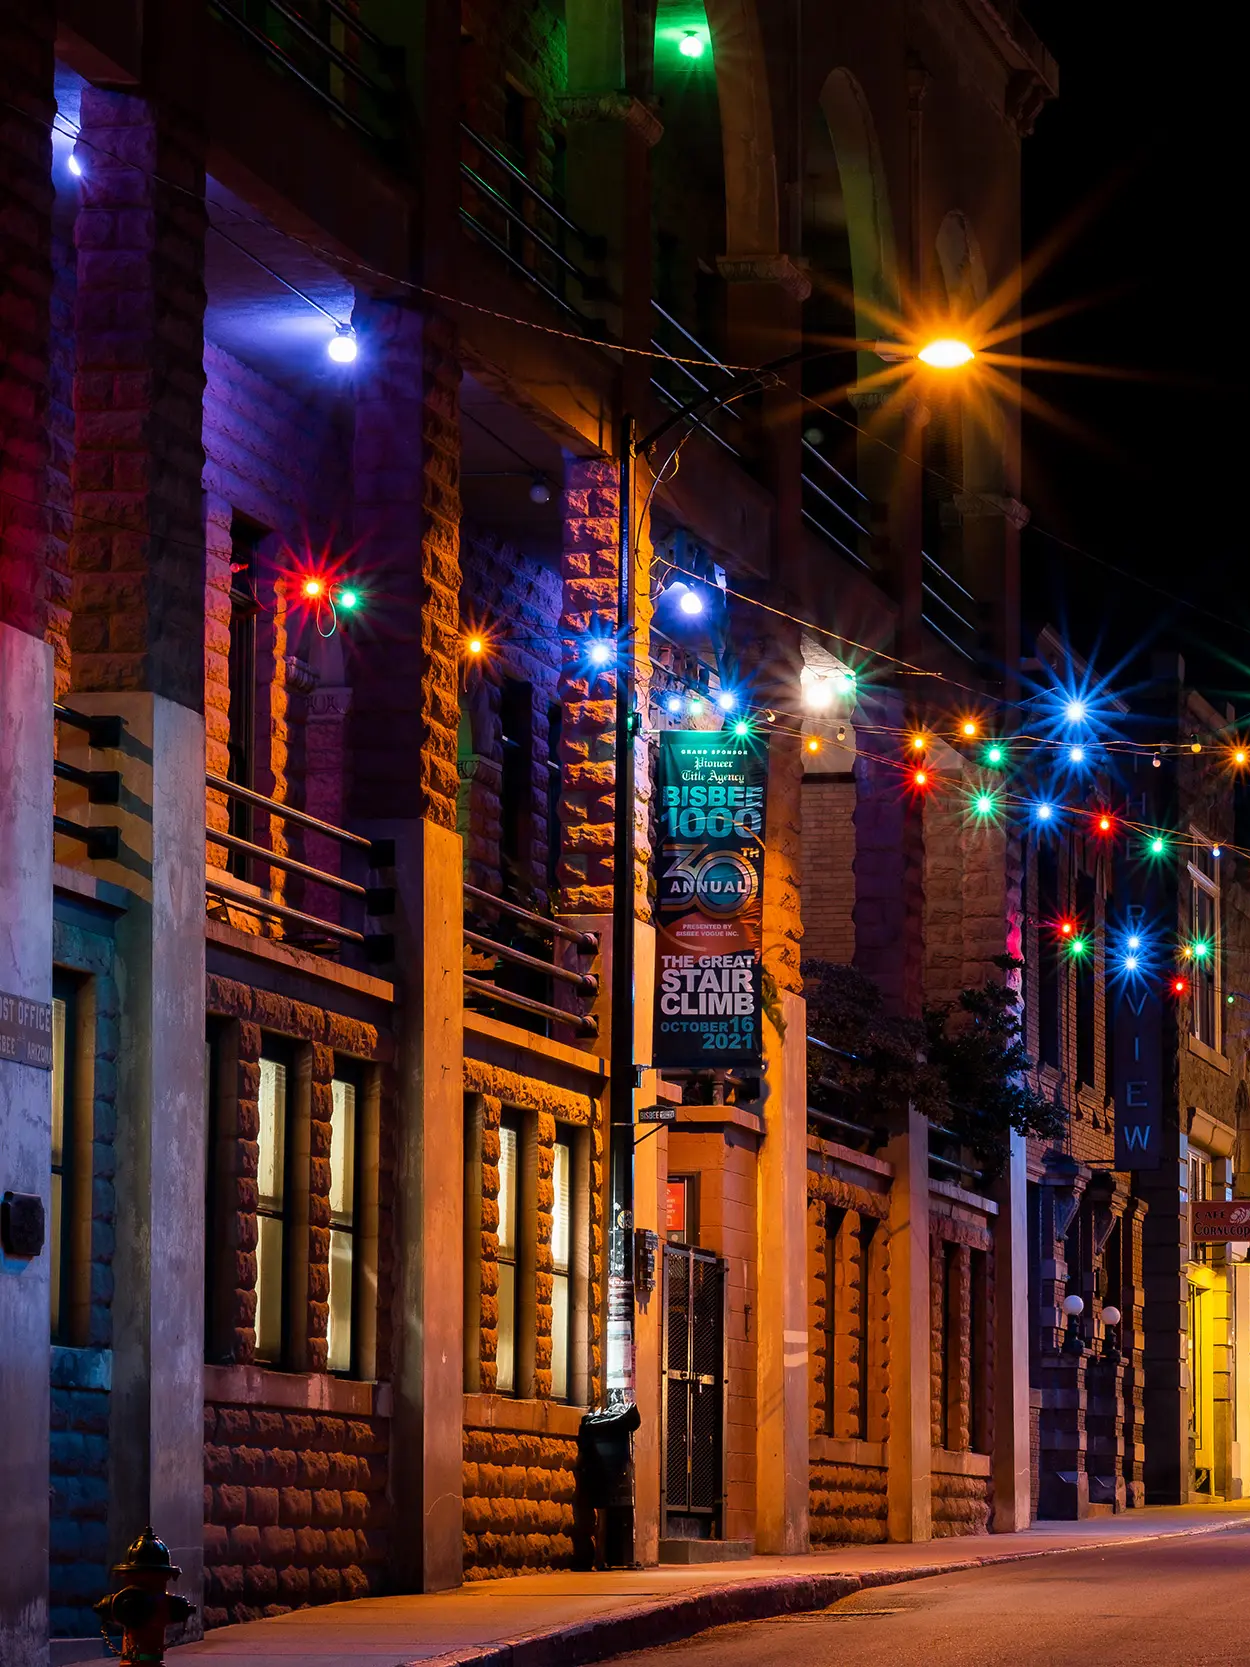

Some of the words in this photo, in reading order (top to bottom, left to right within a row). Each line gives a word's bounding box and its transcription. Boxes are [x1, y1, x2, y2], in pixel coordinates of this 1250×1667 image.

[694, 756, 733, 770] Pioneer
[682, 770, 706, 781] Title
[706, 770, 744, 784] Agency
[662, 786, 764, 807] BISBEE
[660, 807, 762, 838] 1000
[670, 880, 747, 893] ANNUAL
[661, 955, 694, 968] THE
[698, 955, 754, 968] GREAT
[661, 968, 754, 992] STAIR
[660, 992, 754, 1016] CLIMB
[18, 1002, 50, 1032] OFFICE
[660, 1022, 728, 1032] OCTOBER
[729, 1016, 754, 1032] 16
[702, 1033, 753, 1050] 2021
